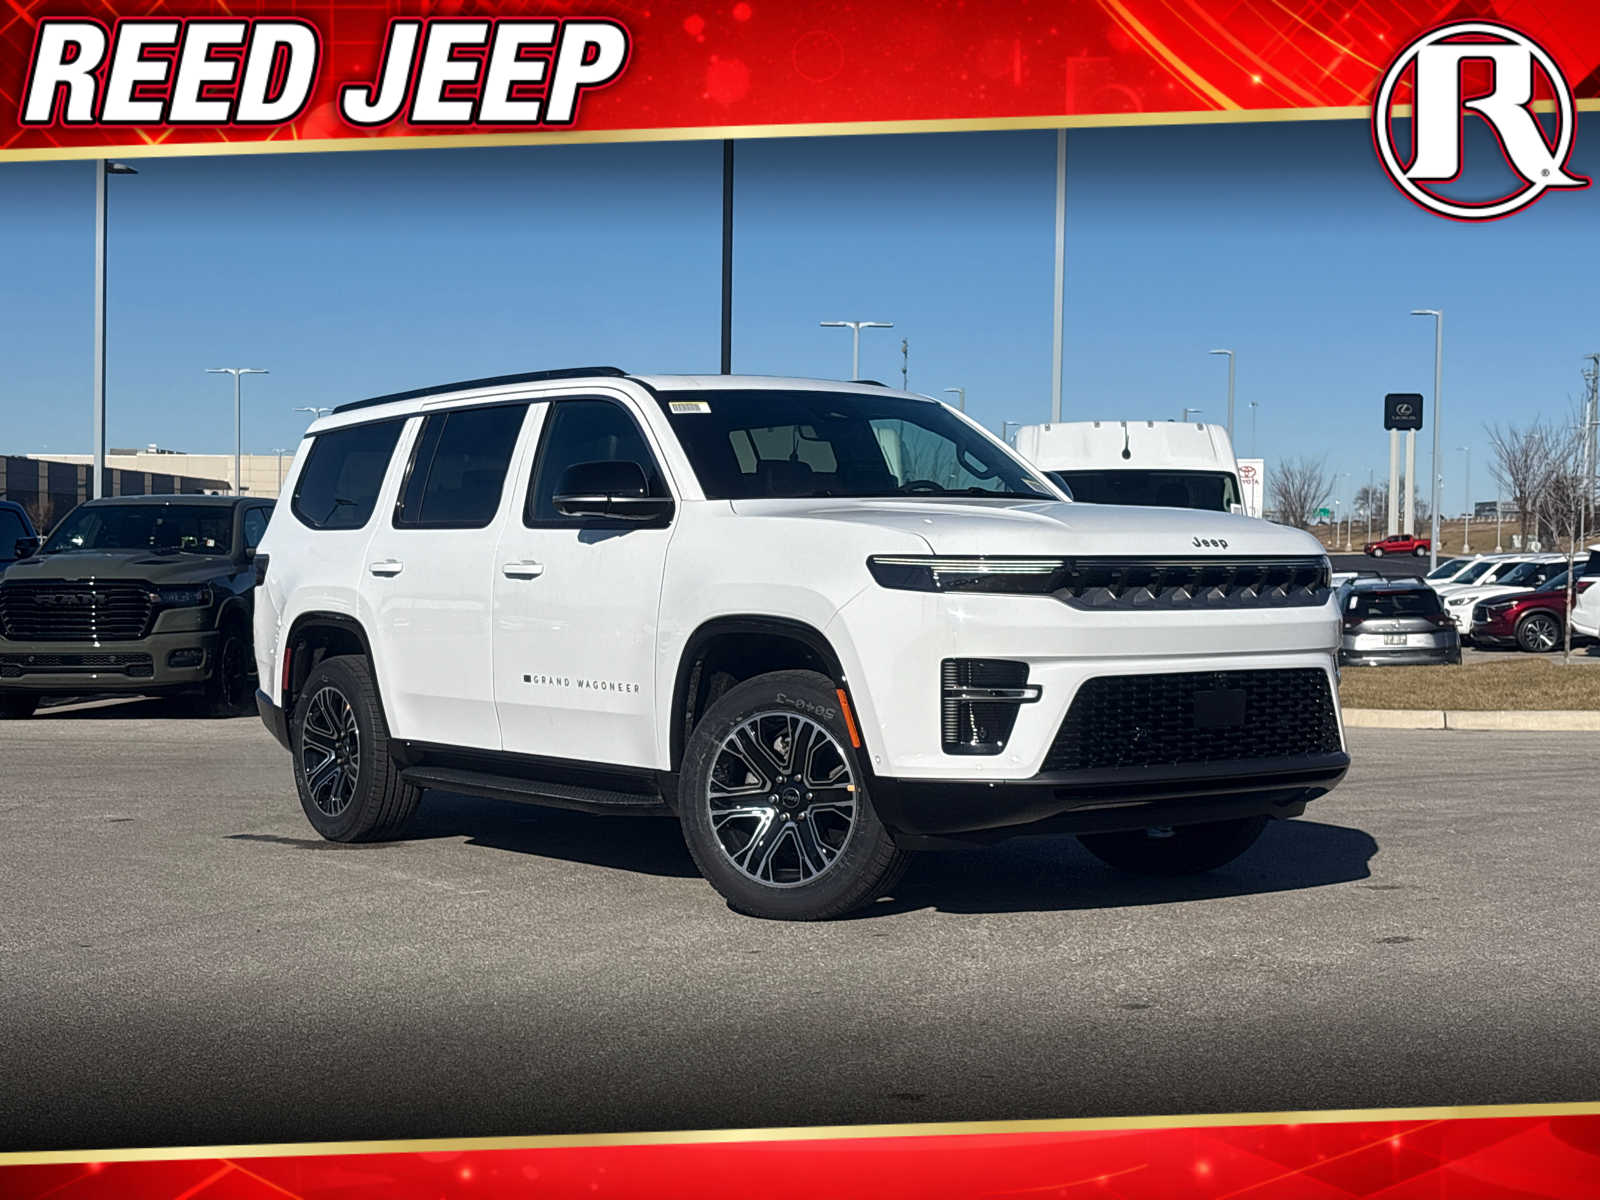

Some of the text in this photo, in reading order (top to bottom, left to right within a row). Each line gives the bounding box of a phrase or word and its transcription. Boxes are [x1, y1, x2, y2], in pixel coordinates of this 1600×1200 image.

[1192, 536, 1228, 550] Jeep
[533, 675, 640, 693] GRAND WAGONEER
